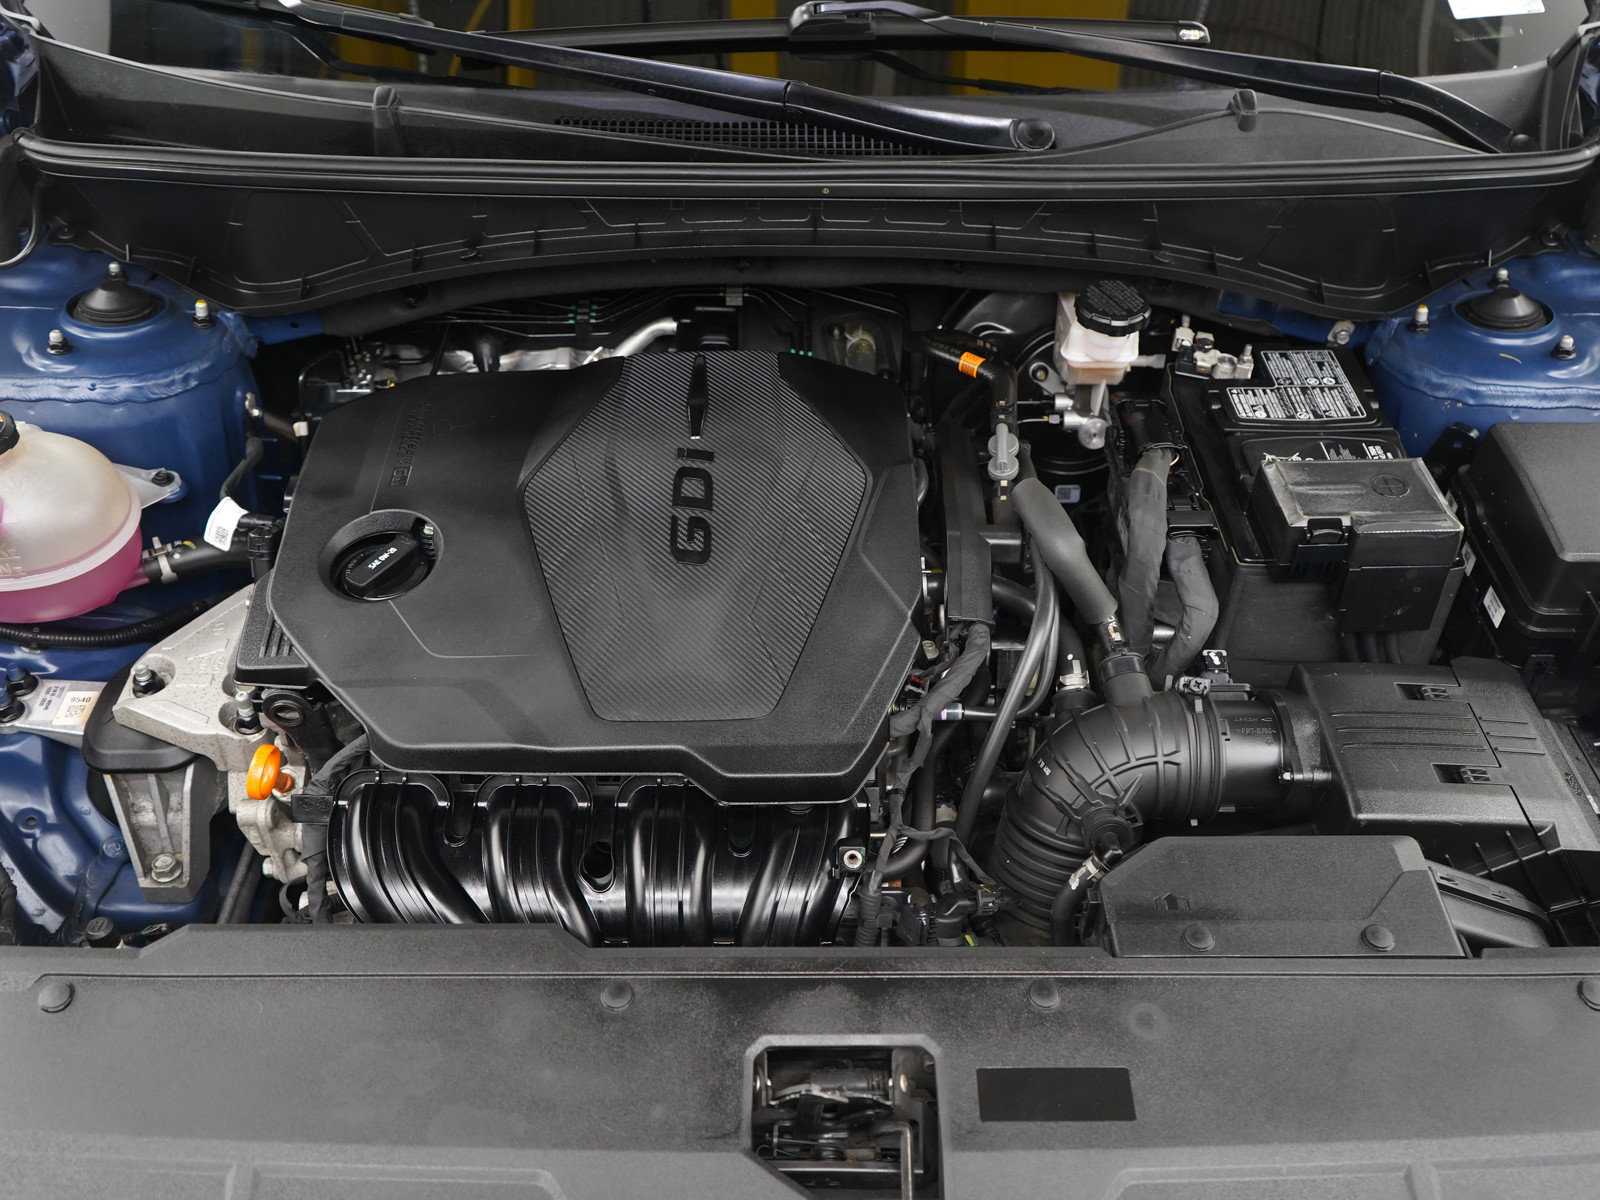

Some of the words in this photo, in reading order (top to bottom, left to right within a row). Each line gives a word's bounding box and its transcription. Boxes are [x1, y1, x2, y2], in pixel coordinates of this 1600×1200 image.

[671, 447, 714, 565] GDi
[367, 559, 382, 570] SAE
[378, 547, 398, 561] 0W-20
[70, 696, 91, 704] 9540
